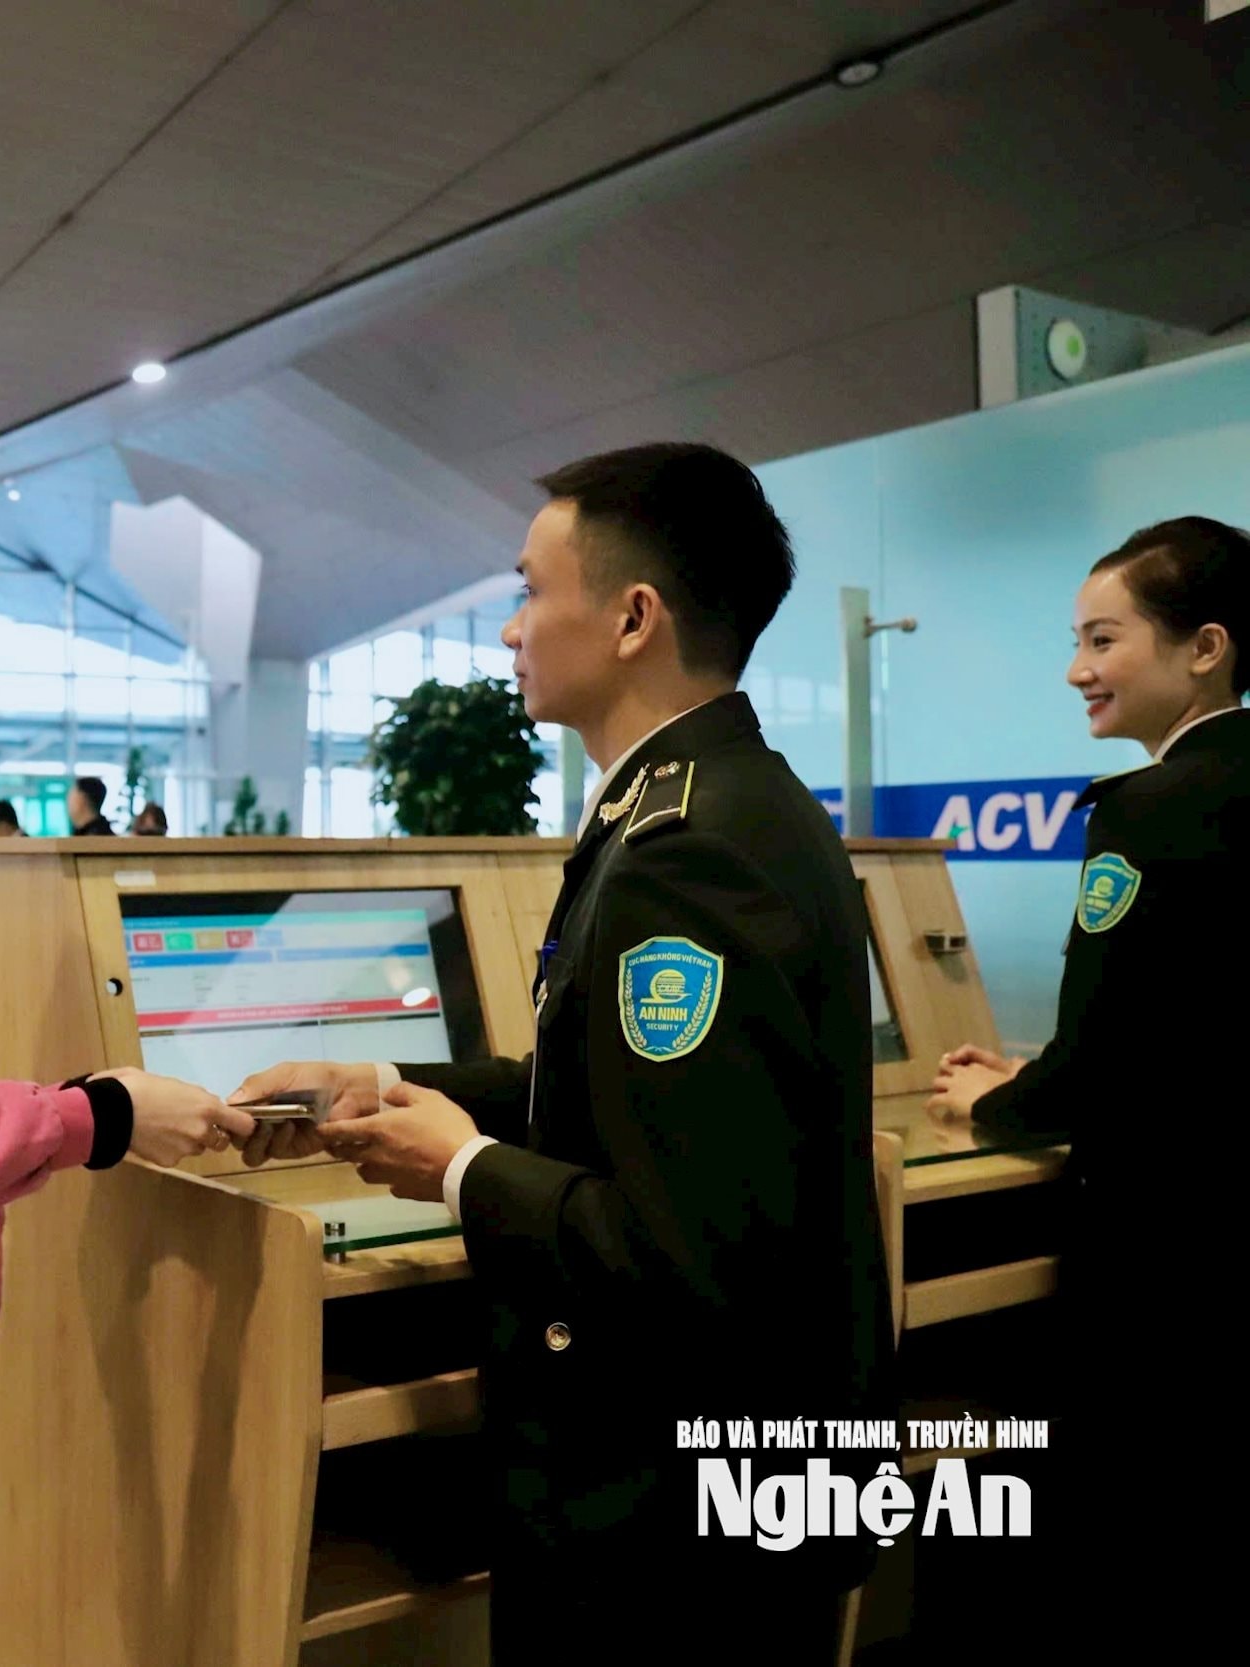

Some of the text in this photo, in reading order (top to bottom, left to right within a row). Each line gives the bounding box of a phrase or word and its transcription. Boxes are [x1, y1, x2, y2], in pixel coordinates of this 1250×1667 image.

[931, 791, 1077, 851] ACV
[639, 1006, 688, 1021] AN NINH
[646, 1023, 679, 1031] SECURITY
